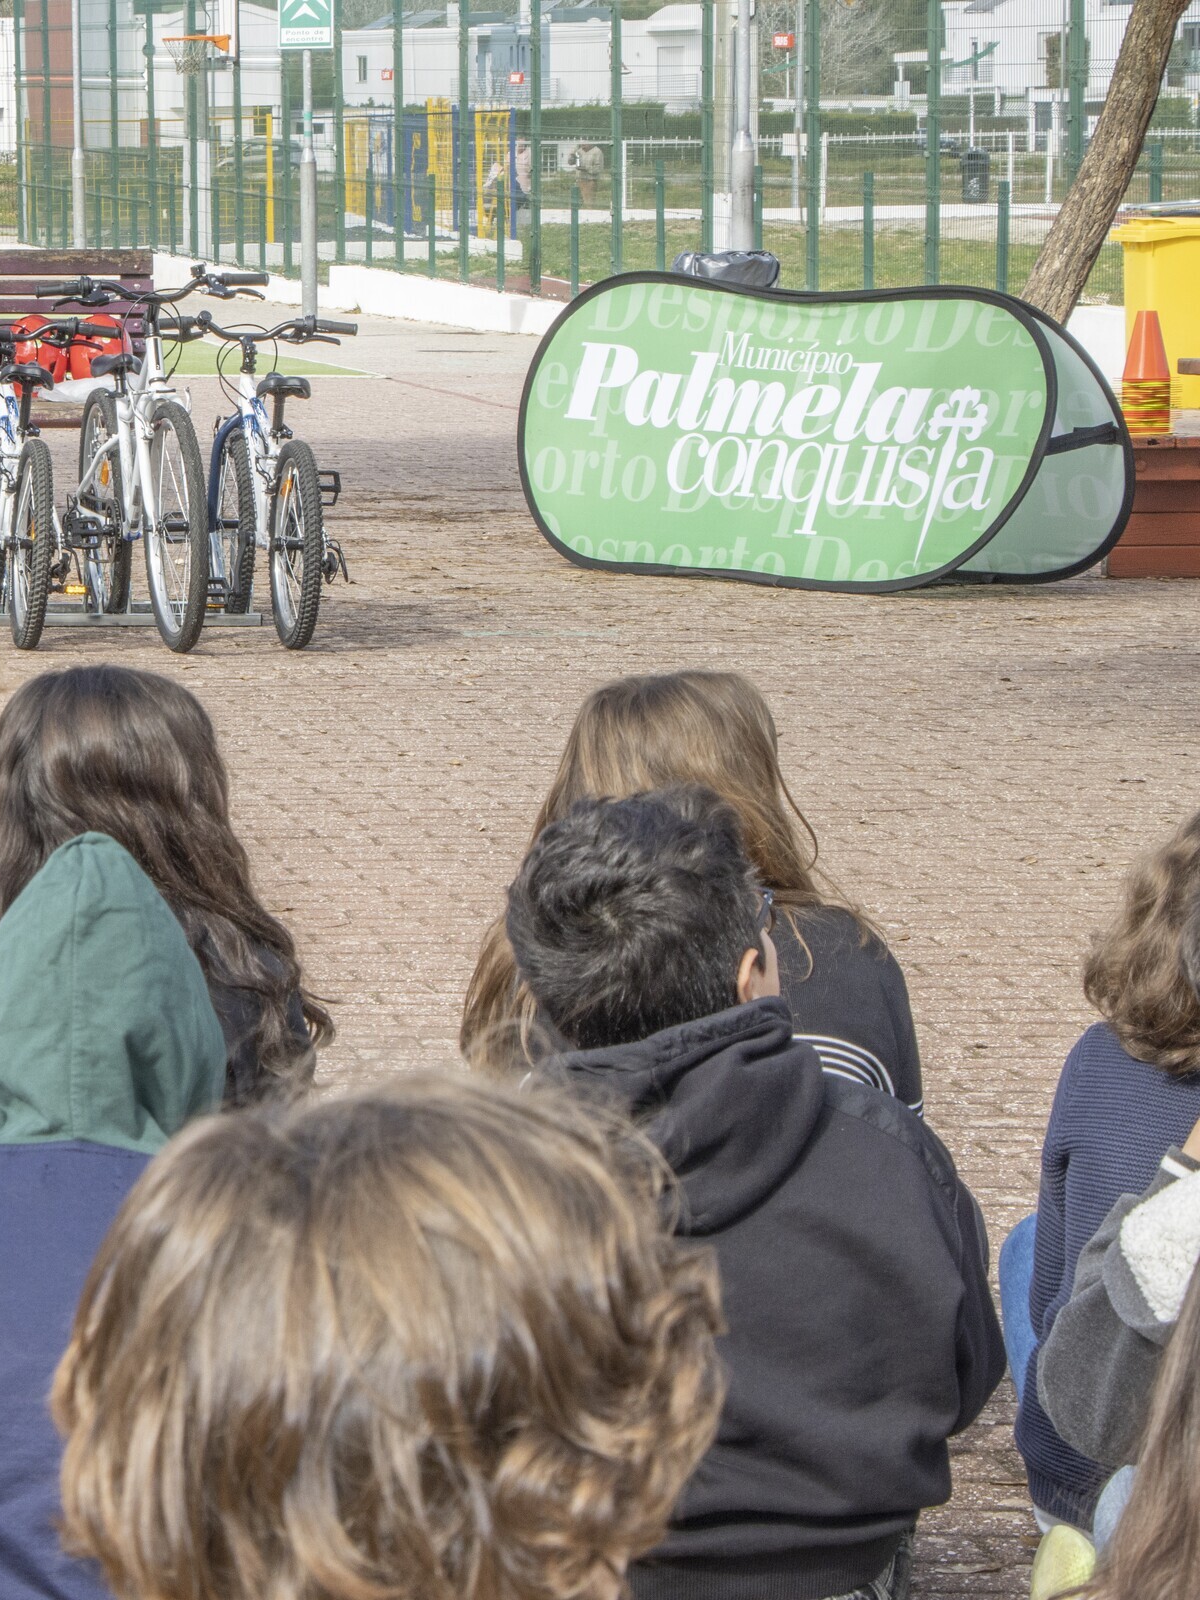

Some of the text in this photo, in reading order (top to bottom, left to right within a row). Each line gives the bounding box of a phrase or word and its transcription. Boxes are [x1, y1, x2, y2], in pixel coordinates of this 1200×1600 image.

[564, 341, 933, 444] Palmela
[716, 331, 854, 384] Município
[666, 432, 995, 567] conquista
